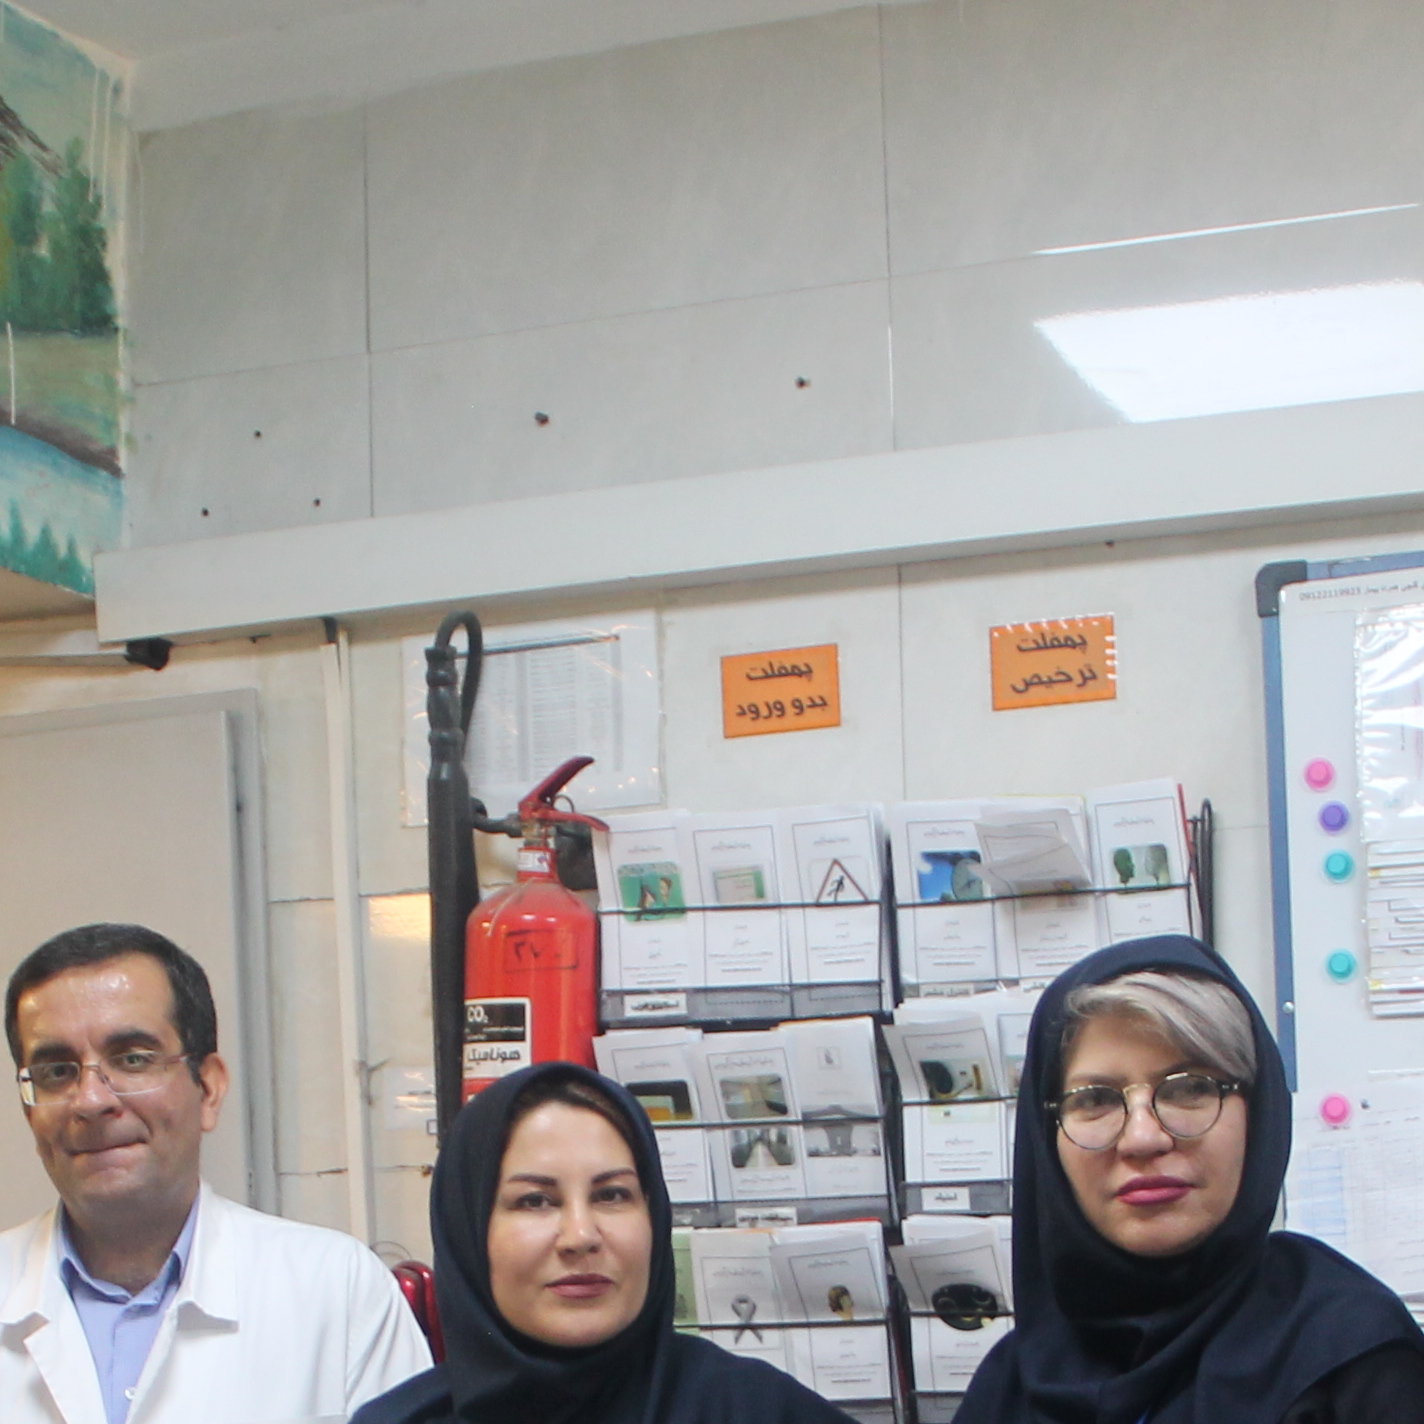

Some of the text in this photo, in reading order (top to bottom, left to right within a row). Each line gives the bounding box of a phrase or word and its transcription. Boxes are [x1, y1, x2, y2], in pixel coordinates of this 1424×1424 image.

[1017, 632, 1087, 654] پمفلت
[745, 660, 813, 681] پمفلت
[1011, 663, 1098, 693] ترخیص
[736, 695, 828, 721] بدو ورود
